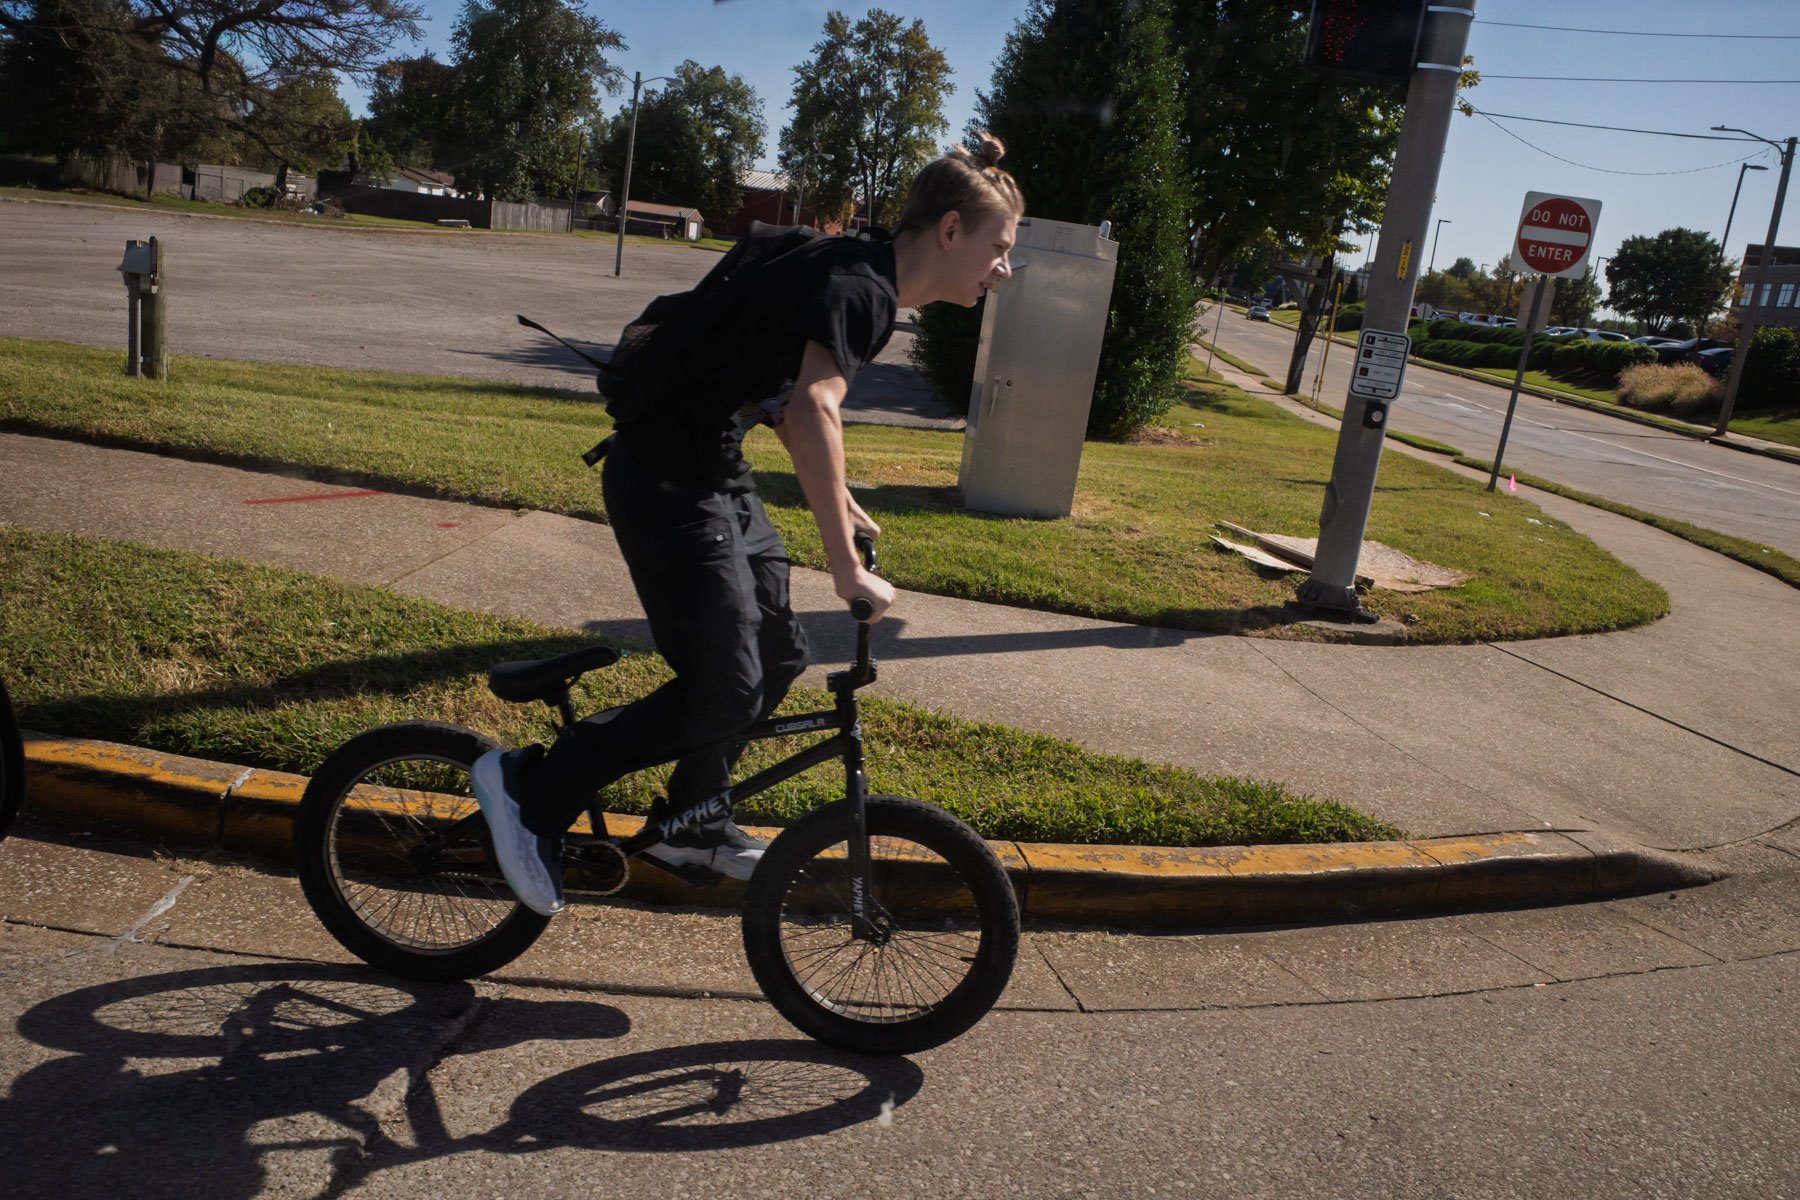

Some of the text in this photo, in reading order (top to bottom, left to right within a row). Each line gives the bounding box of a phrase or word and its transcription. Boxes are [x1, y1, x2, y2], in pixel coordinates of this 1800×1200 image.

[1532, 209, 1586, 227] DO NOT
[1528, 244, 1573, 261] ENTER
[659, 789, 733, 839] YAPHET
[852, 877, 864, 918] YAPHET
